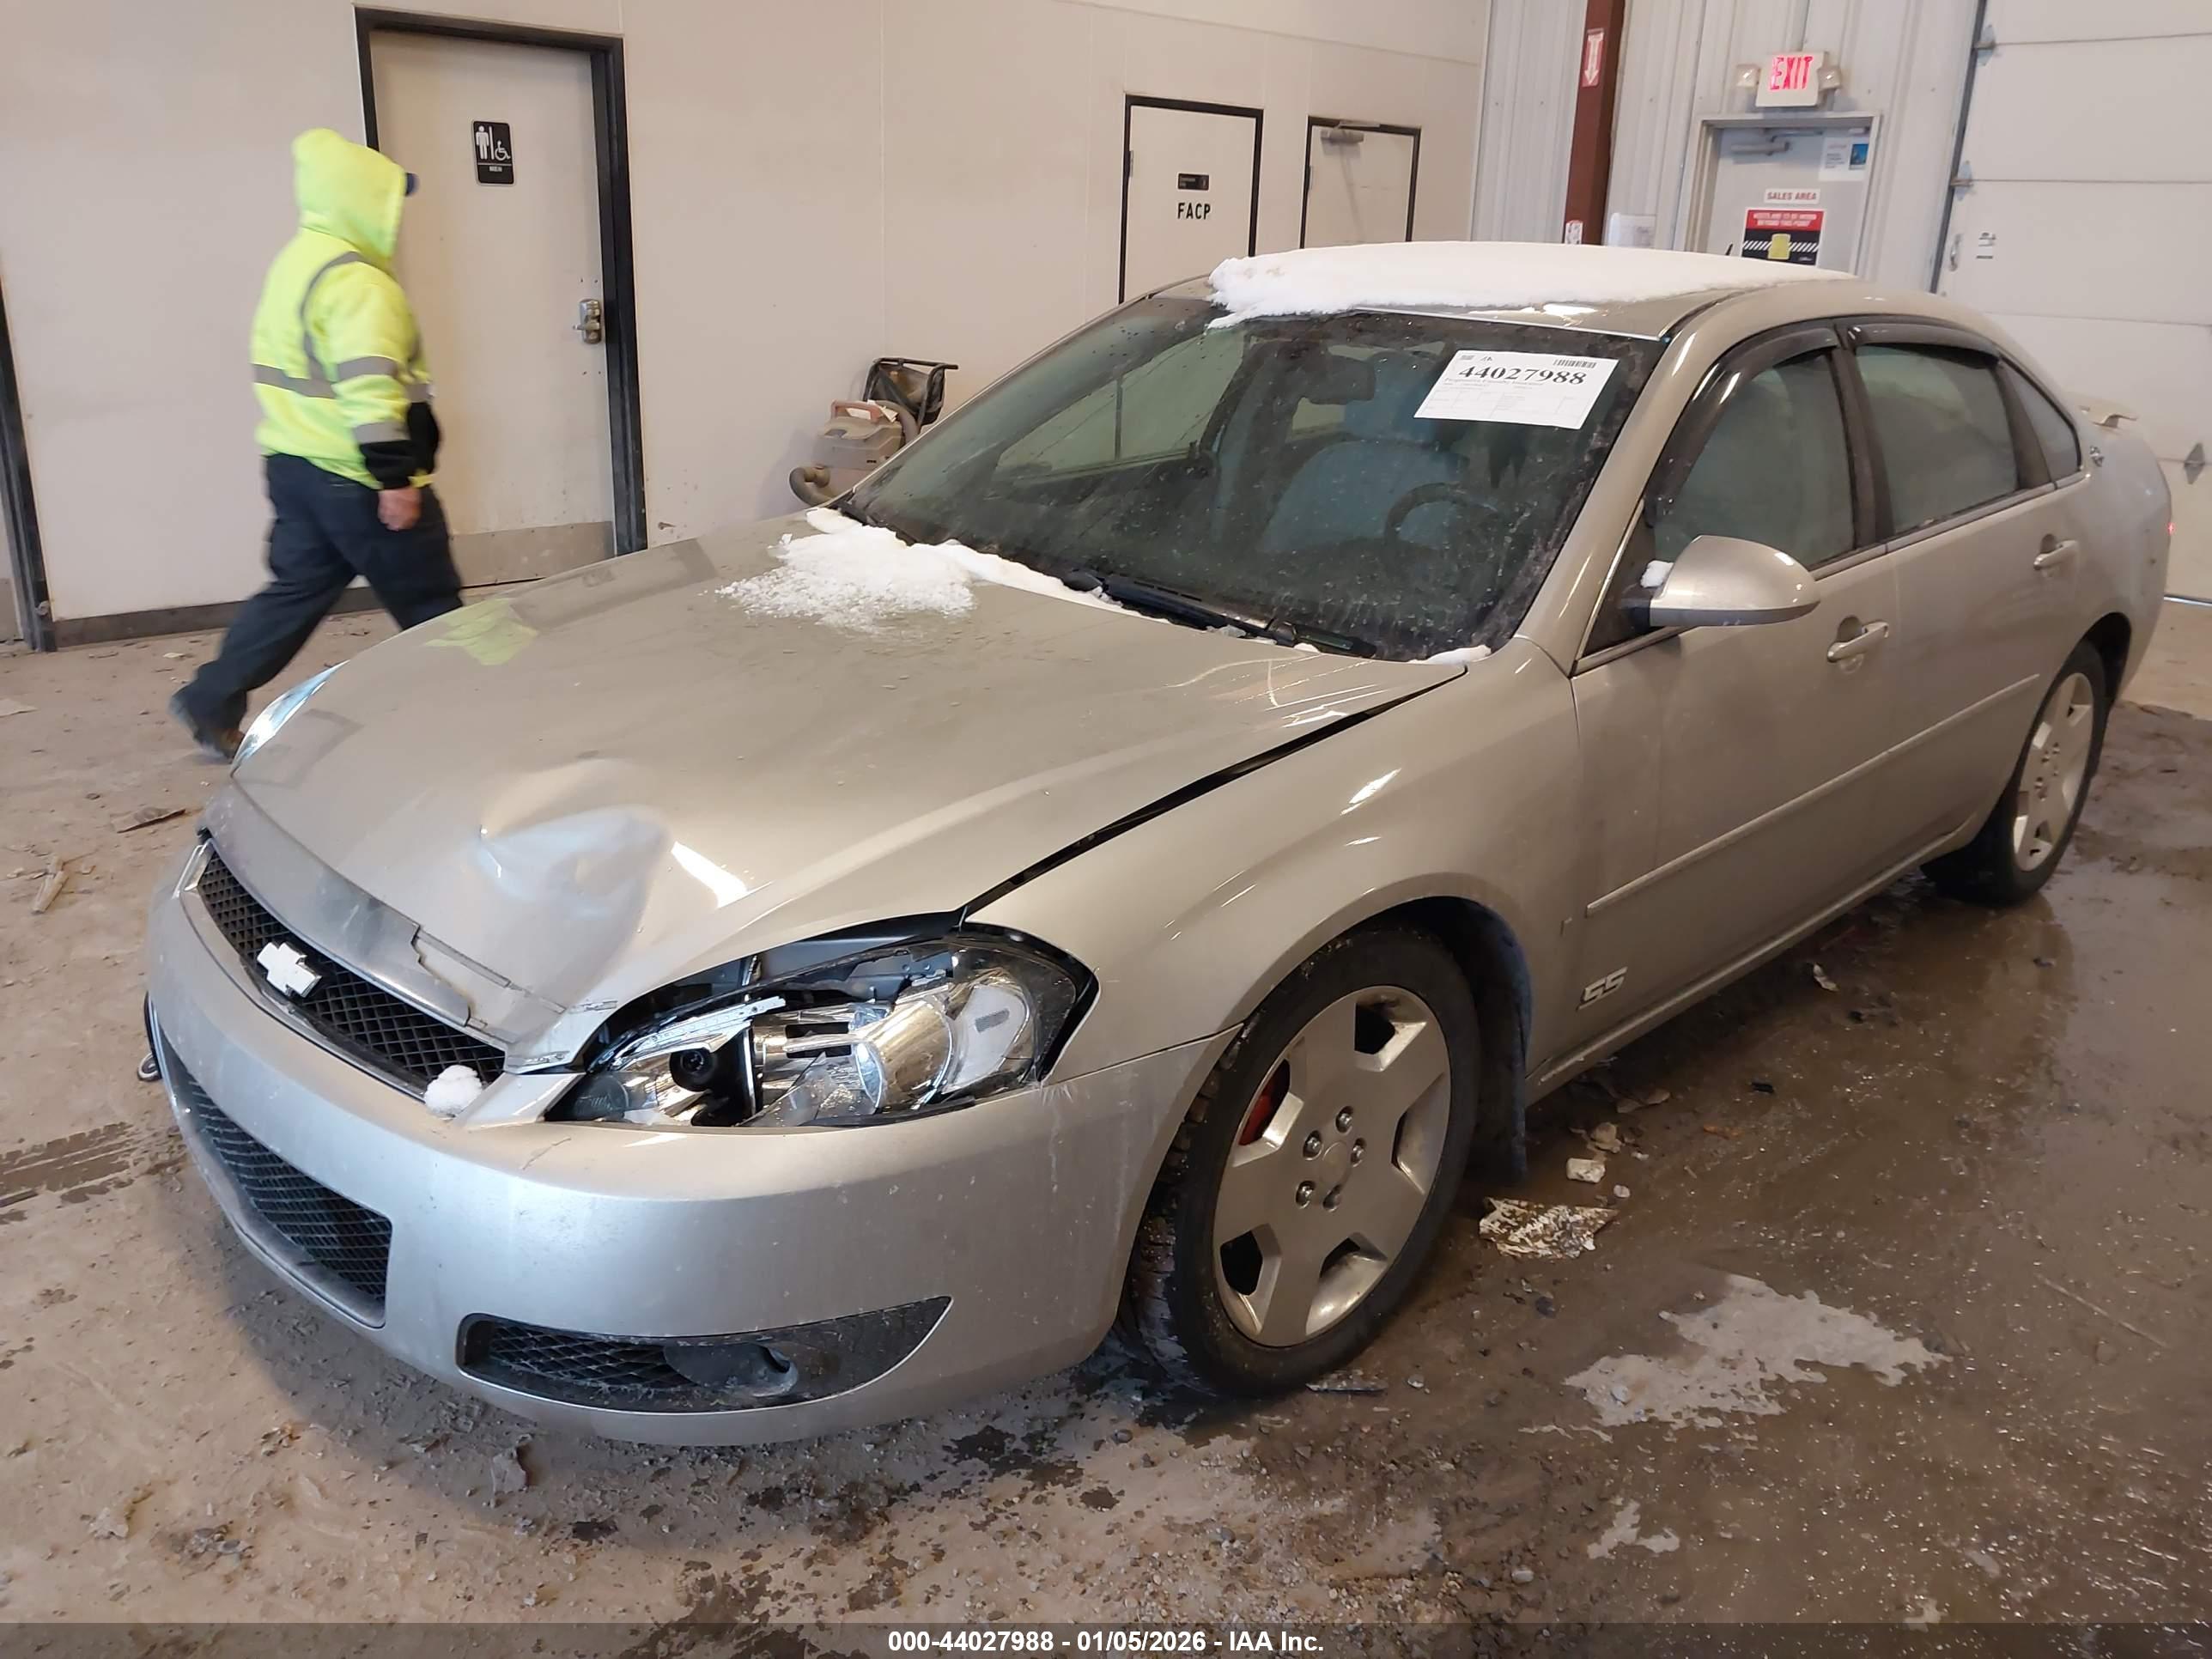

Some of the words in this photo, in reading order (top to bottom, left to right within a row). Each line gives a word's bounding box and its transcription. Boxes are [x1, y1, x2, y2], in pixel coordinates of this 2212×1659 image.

[1770, 56, 1813, 90] EXIT
[1767, 191, 1792, 200] SALES
[1795, 191, 1817, 200] AREA
[1177, 202, 1211, 220] FACP
[1458, 366, 1587, 386] 44027988
